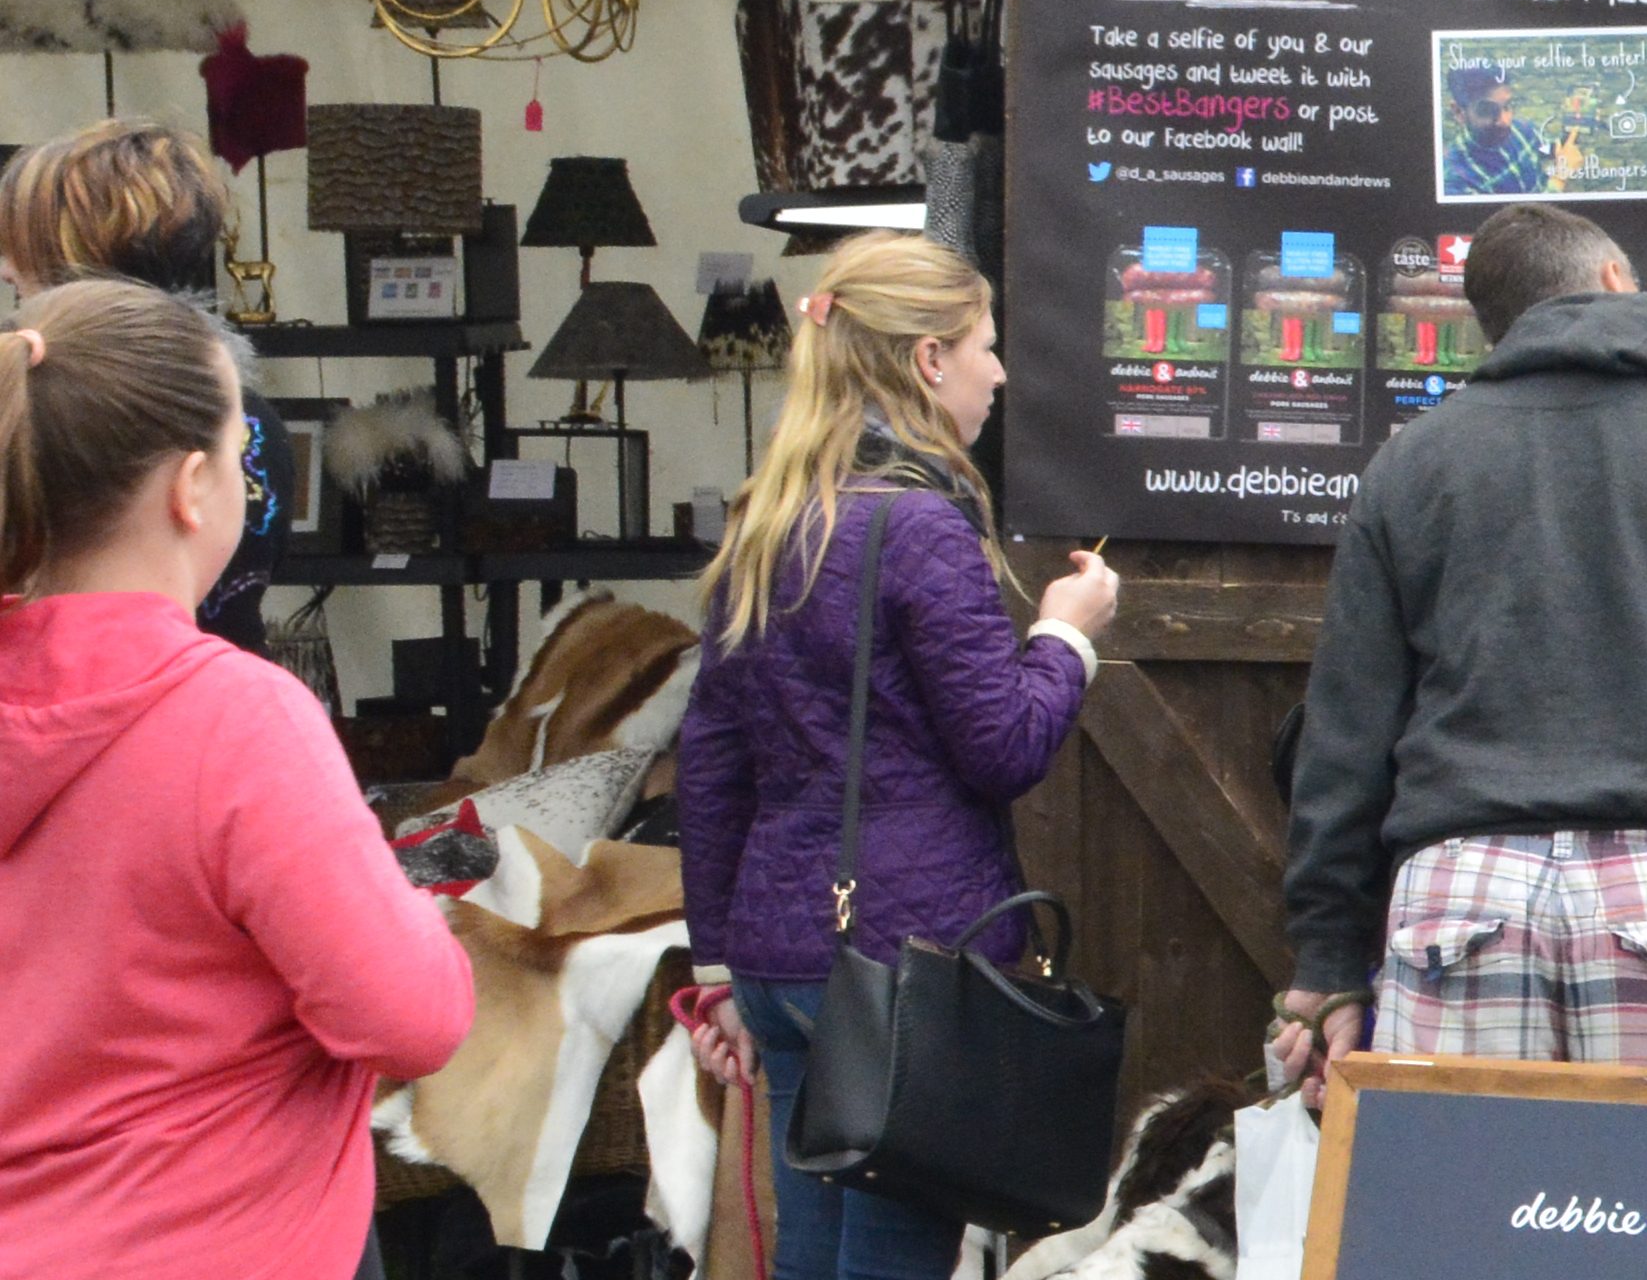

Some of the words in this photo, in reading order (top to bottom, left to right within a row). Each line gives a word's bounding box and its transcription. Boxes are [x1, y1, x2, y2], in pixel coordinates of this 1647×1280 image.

[1090, 25, 1138, 47] Take
[1147, 31, 1160, 49] a
[1167, 26, 1225, 50] selfie
[1234, 28, 1258, 51] of
[1267, 34, 1305, 60] you
[1314, 32, 1331, 54] &
[1339, 37, 1373, 56] our
[1089, 61, 1179, 91] sausages
[1185, 63, 1221, 86] and
[1229, 65, 1292, 86] tweet
[1300, 65, 1319, 87] it
[1326, 66, 1371, 88] with
[1449, 43, 1491, 70] Share
[1497, 55, 1526, 83] your
[1534, 43, 1574, 68] selfie
[1582, 44, 1595, 68] to
[1601, 42, 1645, 67] enter!
[1088, 87, 1290, 133] #BestBangers
[1297, 103, 1320, 122] or
[1329, 105, 1380, 131] post
[1086, 127, 1112, 146] to
[1120, 129, 1155, 148] our
[1164, 127, 1252, 150] Facebook
[1261, 132, 1303, 153] wall!
[1116, 168, 1225, 183] @d_a_sausages
[1262, 171, 1391, 188] debbieandandrews
[1547, 156, 1647, 191] #BestBangers
[1394, 253, 1430, 266] taste
[1146, 465, 1358, 499] www.debbiean
[1305, 512, 1327, 525] and
[1510, 1191, 1647, 1235] debbie
